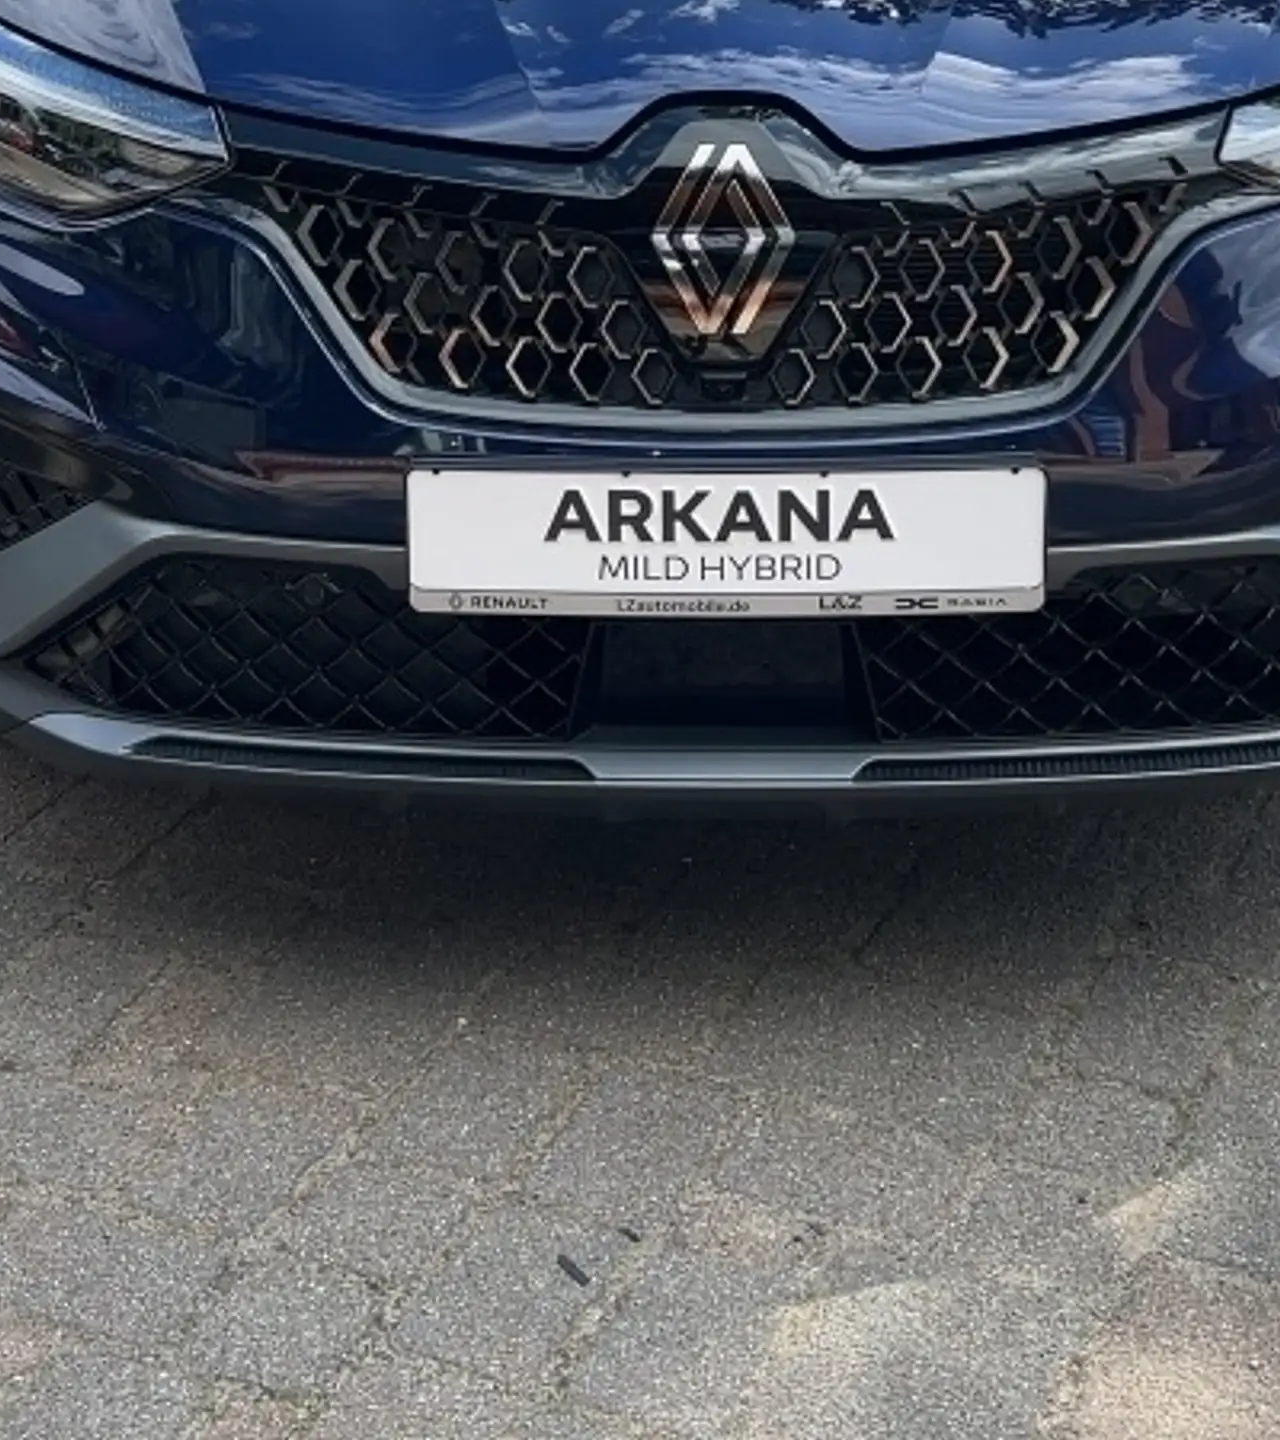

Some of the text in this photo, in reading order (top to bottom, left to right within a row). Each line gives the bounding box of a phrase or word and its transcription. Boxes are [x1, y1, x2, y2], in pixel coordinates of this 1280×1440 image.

[543, 489, 896, 543] ARKANA
[598, 553, 843, 581] MILD HYBRID
[470, 595, 549, 610] RENAULT
